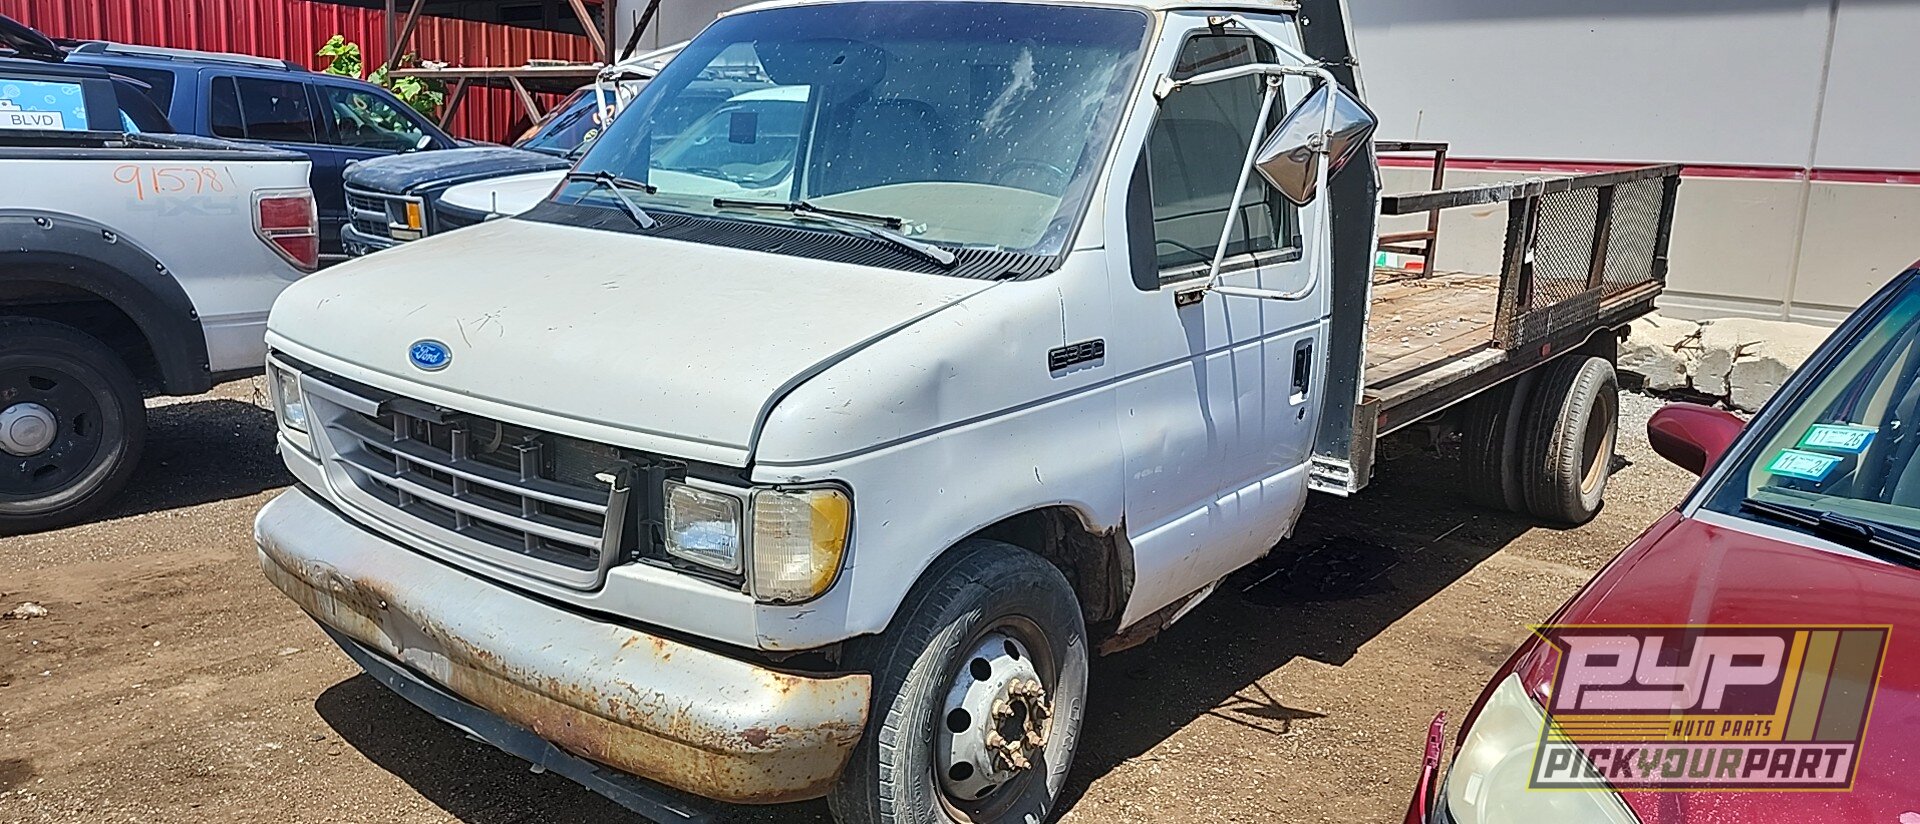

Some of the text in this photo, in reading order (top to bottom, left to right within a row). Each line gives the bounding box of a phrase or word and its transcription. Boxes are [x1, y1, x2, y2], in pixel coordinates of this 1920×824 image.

[11, 114, 54, 126] BLVD
[411, 344, 441, 363] Ford
[1050, 340, 1104, 367] E350
[1843, 432, 1865, 447] 26
